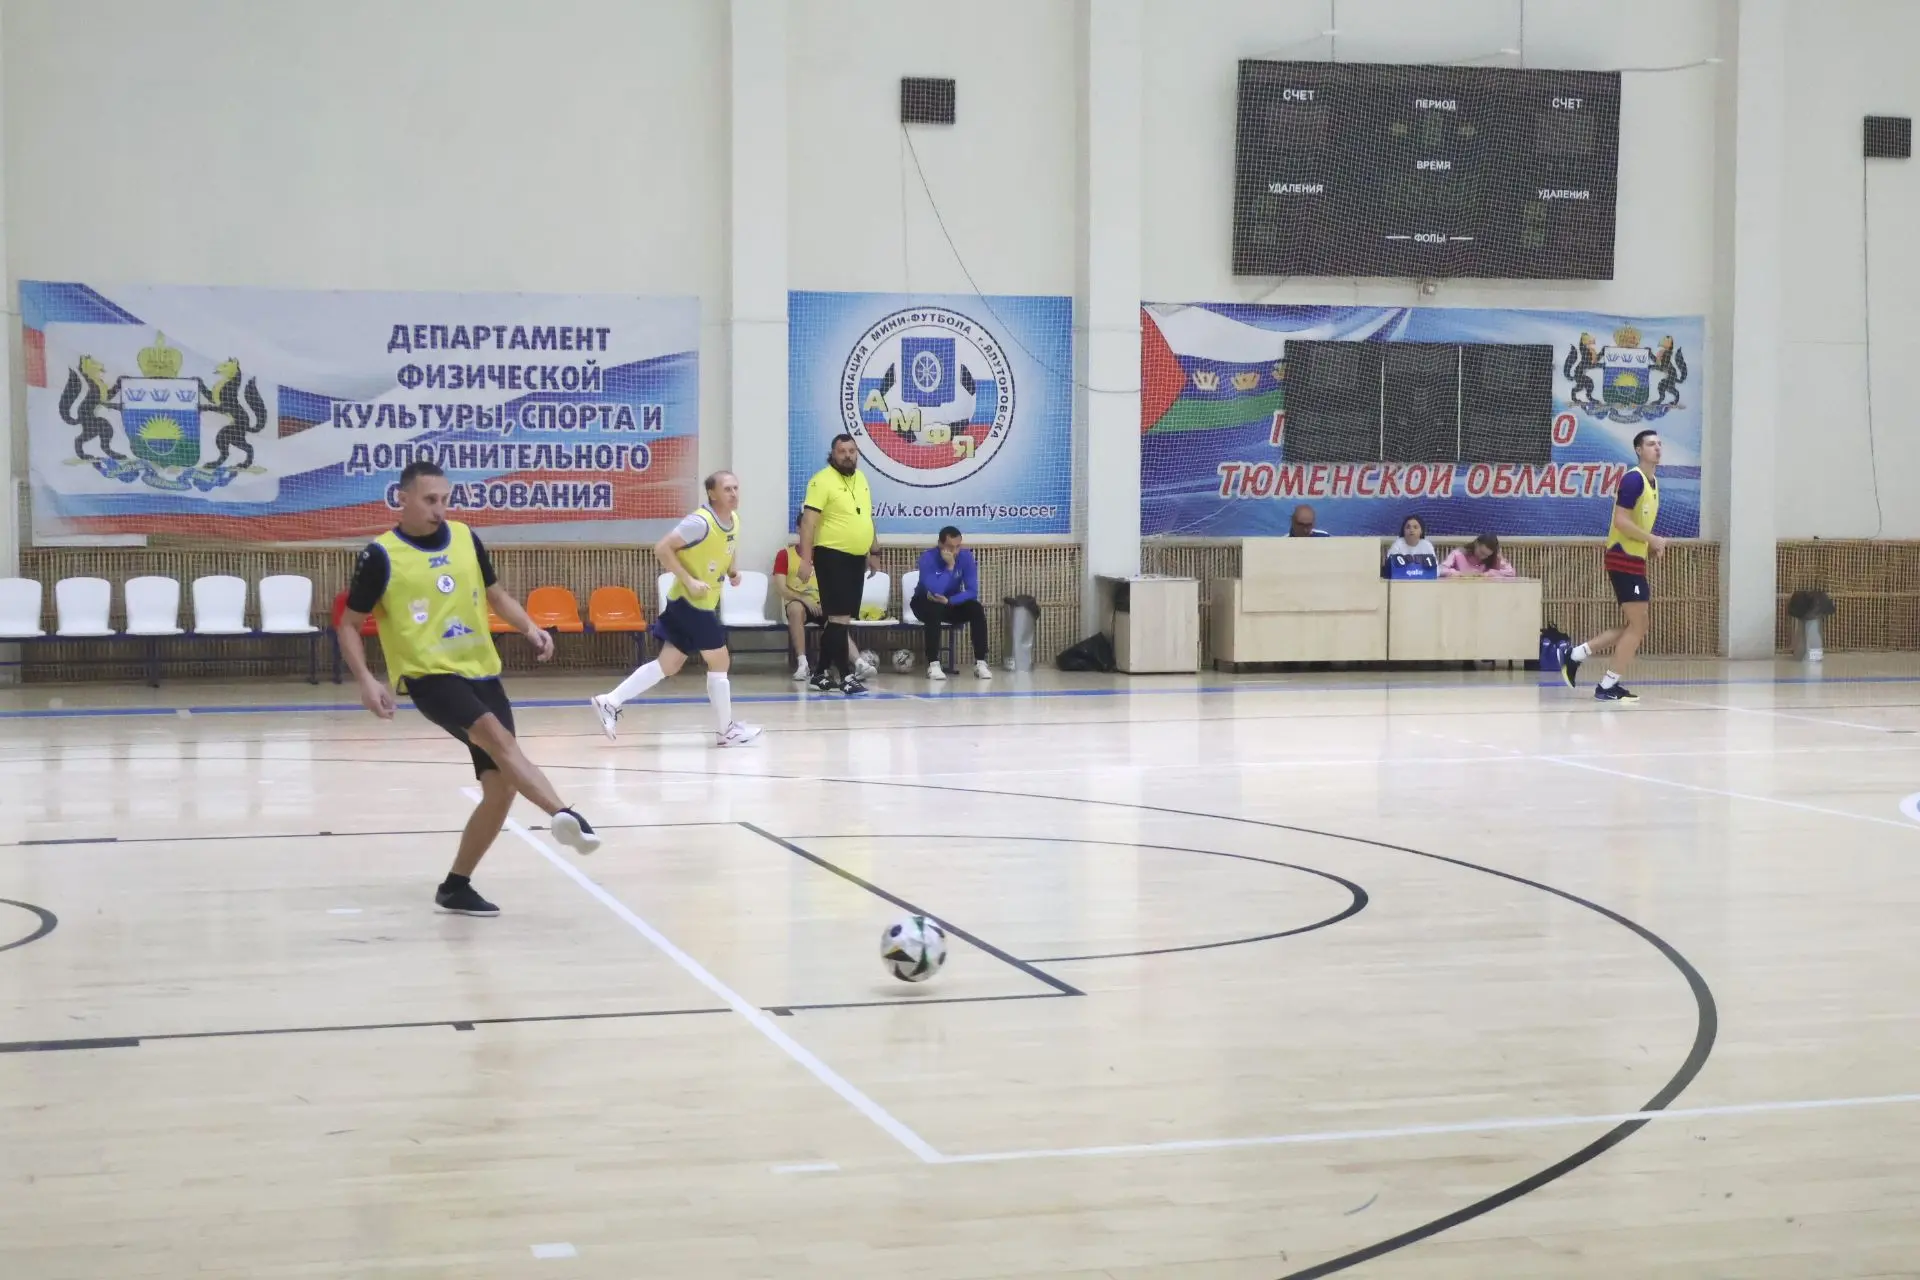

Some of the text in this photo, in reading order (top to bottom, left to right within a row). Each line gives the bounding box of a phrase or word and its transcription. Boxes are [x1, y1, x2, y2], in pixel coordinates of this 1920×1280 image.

[1283, 90, 1314, 101] СЧЕТ
[1415, 99, 1456, 111] ПЕРИОД
[1552, 98, 1583, 109] СЧЕТ
[1416, 160, 1451, 170] ВРЕМЯ
[1269, 183, 1324, 194] УДАЛЕНИЯ
[1538, 189, 1590, 200] УДАЛЕНИЯ
[387, 324, 611, 354] ДЕПАРТАМЕНТ
[397, 359, 602, 390] ФИЗИЧЕСКОЙ
[845, 345, 869, 436] АССОЦИАЦИЯ
[870, 313, 972, 341] МИНИ-ФУТБОЛА
[333, 403, 662, 435] КУЛЬТУРЫ, СПОРТА И
[348, 443, 650, 474] ДОПОЛНИТЕЛЬНОГО
[1467, 464, 1625, 497] ОБЛАСТИ
[387, 482, 611, 509] ОАЗОВАНИЯ
